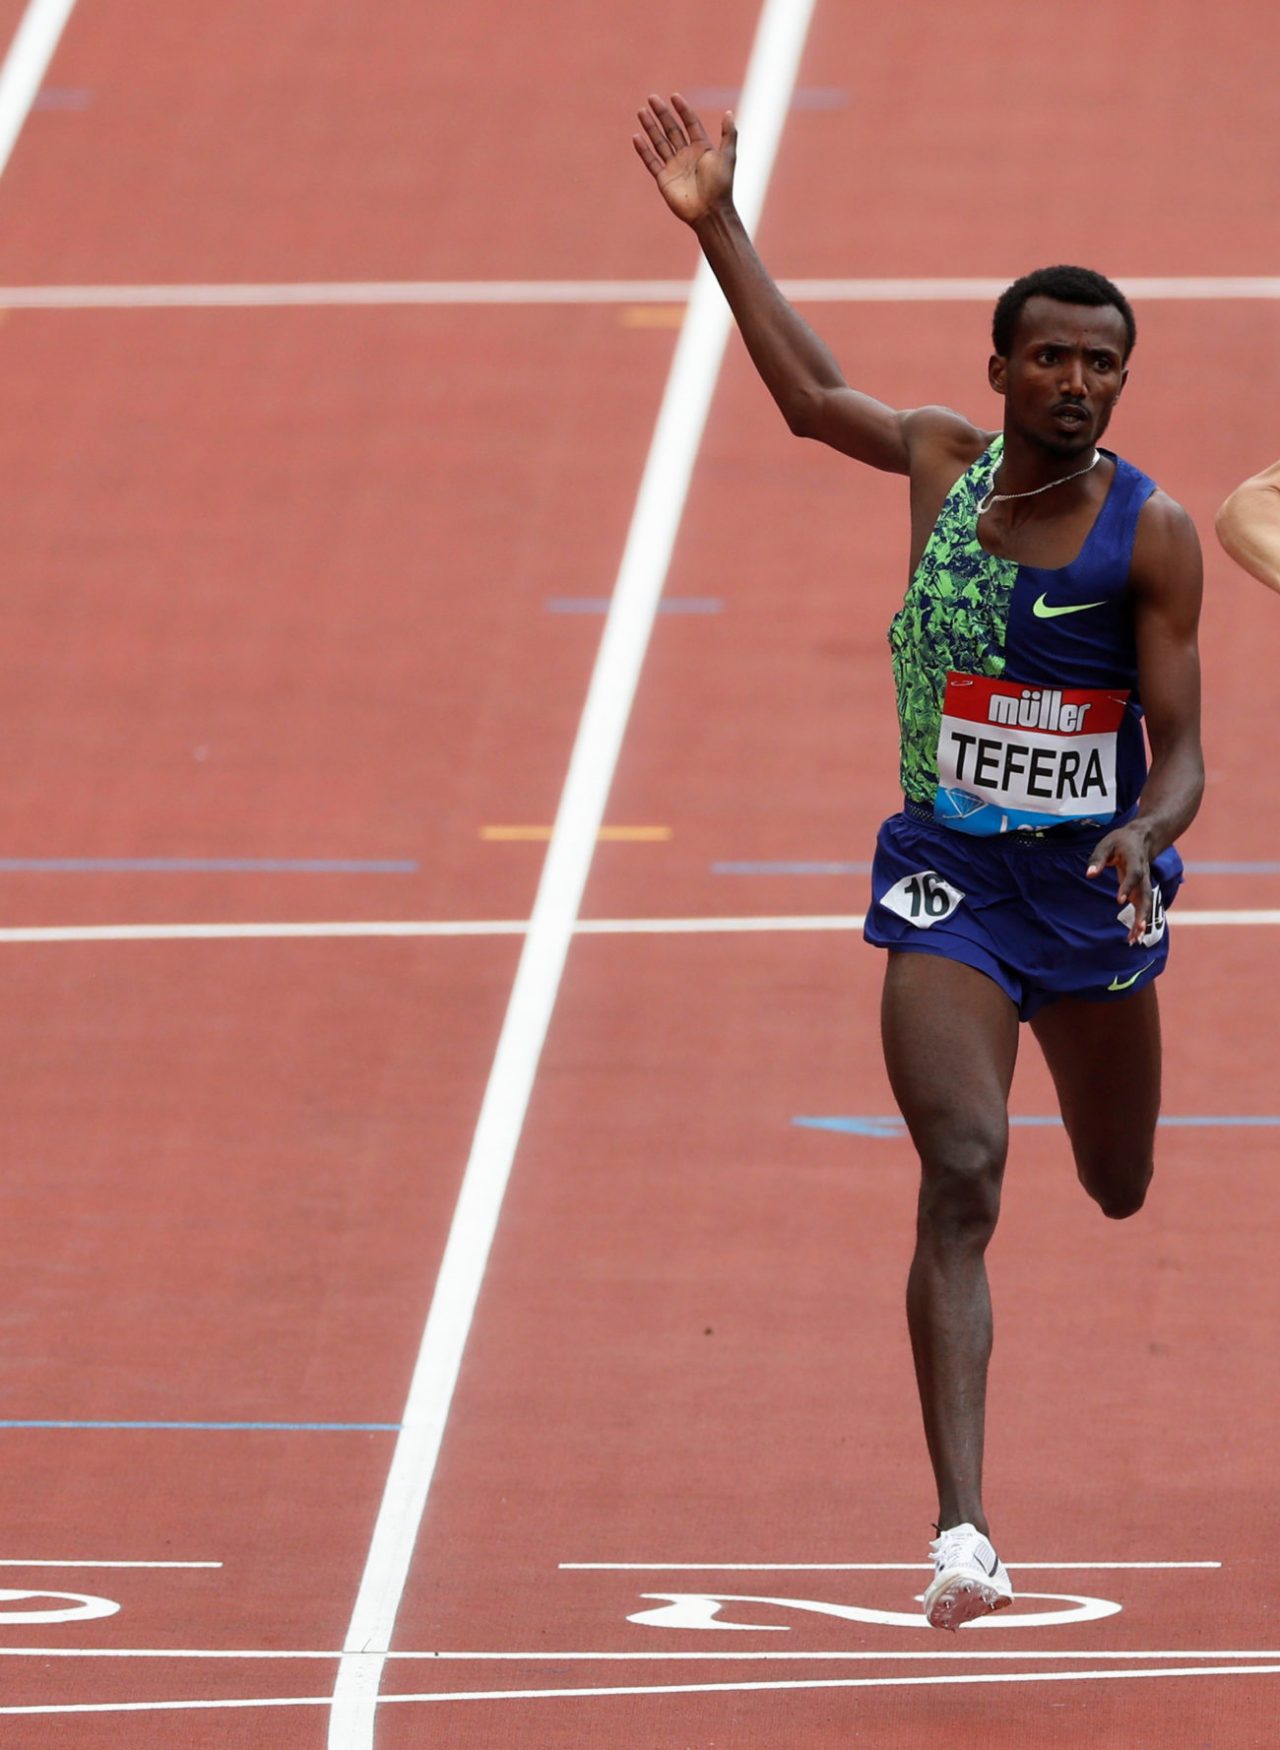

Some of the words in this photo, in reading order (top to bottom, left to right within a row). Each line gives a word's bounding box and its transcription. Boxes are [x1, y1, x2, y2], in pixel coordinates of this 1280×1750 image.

[989, 690, 1091, 732] müller
[951, 732, 1108, 799] TEFERA
[904, 873, 950, 918] 16
